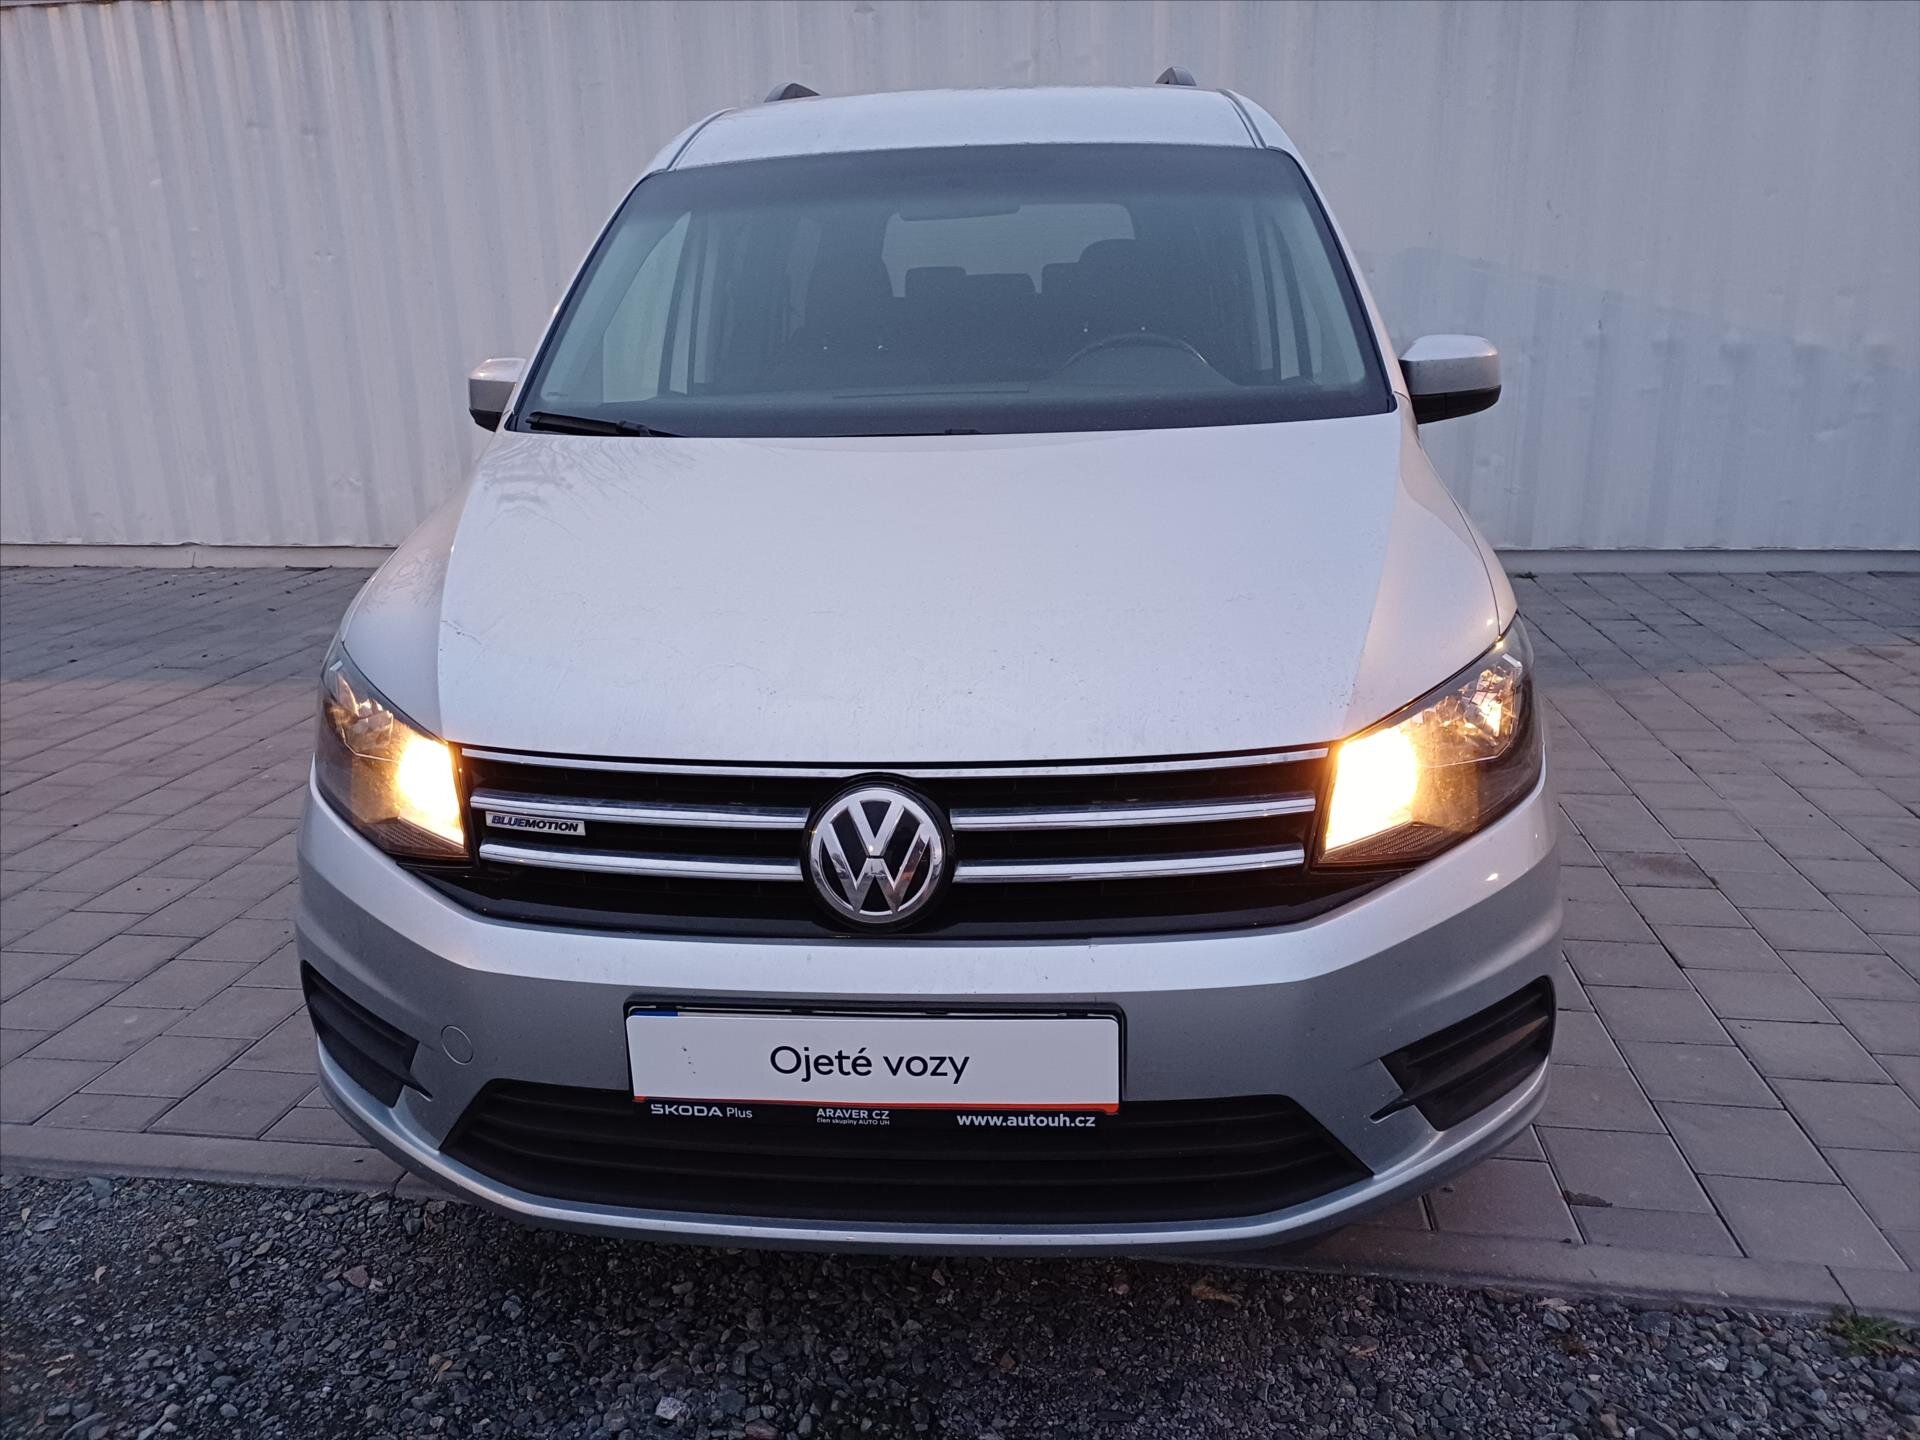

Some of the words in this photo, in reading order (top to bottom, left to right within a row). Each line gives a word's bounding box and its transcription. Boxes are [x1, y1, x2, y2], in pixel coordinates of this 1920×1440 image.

[491, 815, 579, 832] BLUEMOTION
[815, 791, 938, 920] VW
[770, 1045, 873, 1083] Ojeté
[882, 1055, 970, 1085] vozy
[726, 1106, 753, 1119] Plus
[816, 1108, 868, 1119] ARAVER
[872, 1110, 890, 1119] CZ
[956, 1113, 1096, 1127] www.autouh.cz
